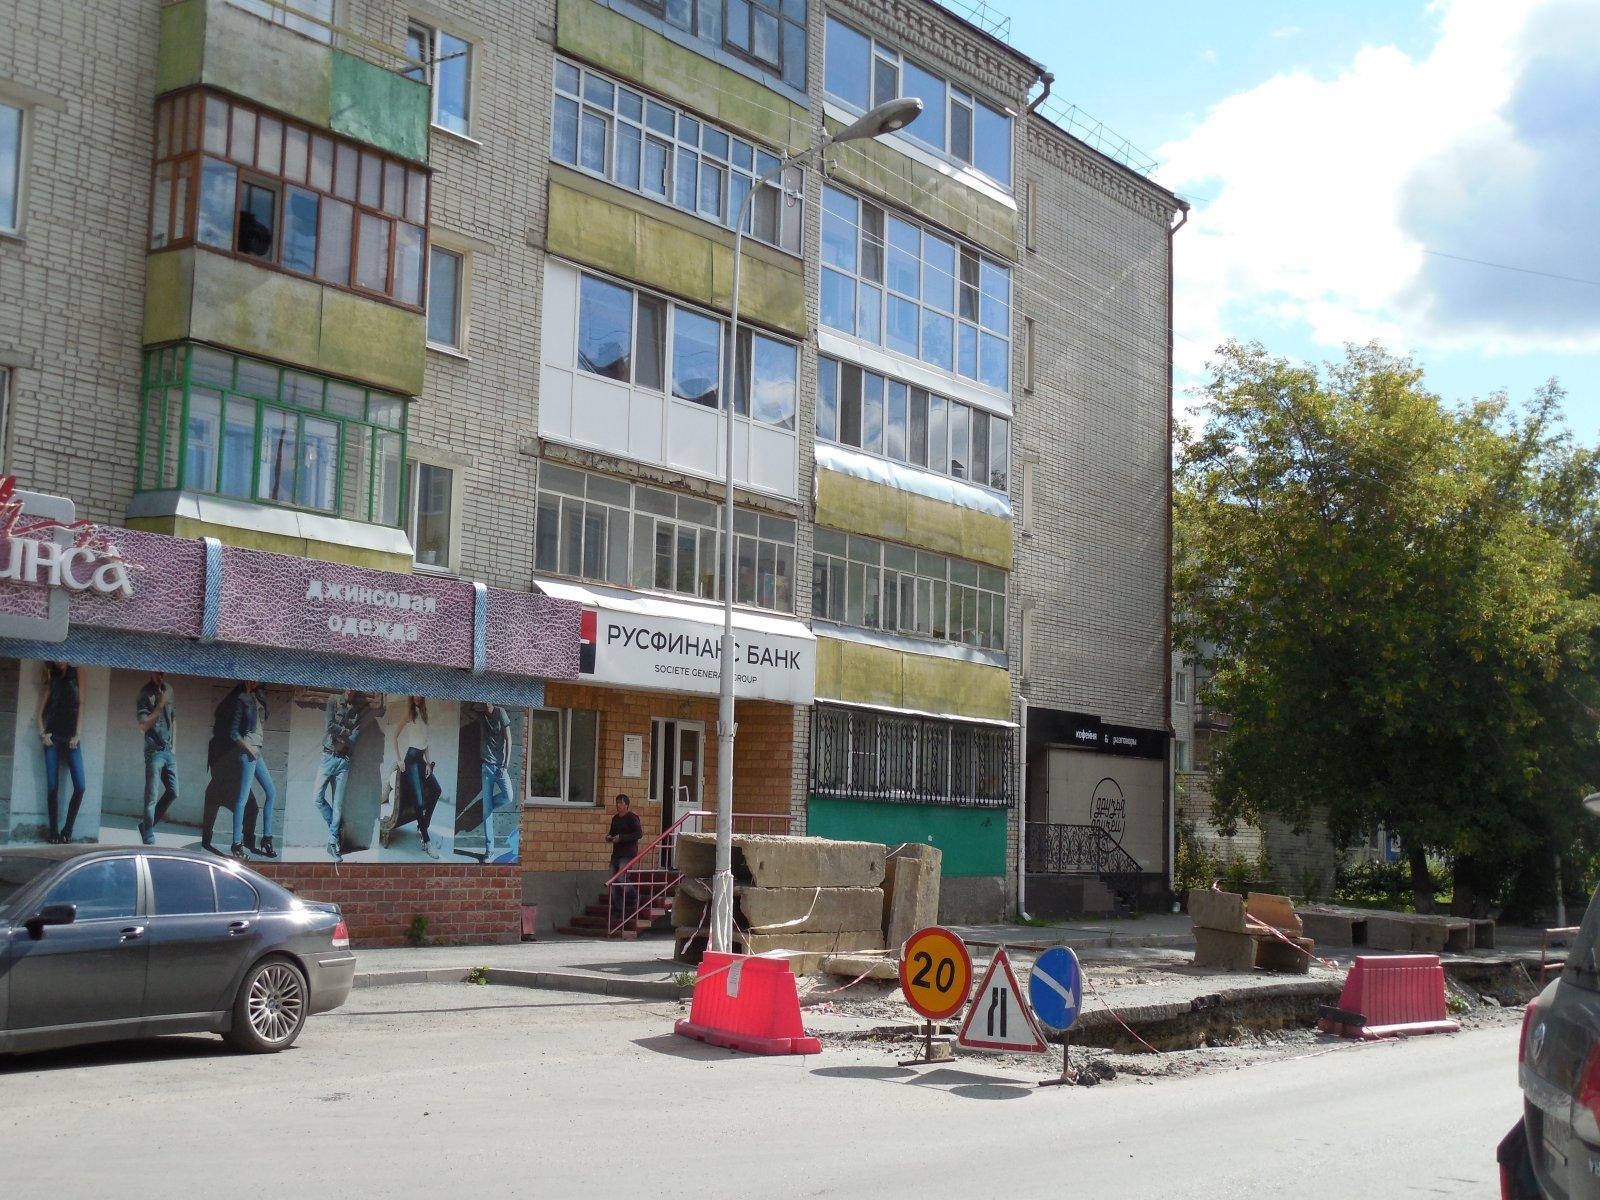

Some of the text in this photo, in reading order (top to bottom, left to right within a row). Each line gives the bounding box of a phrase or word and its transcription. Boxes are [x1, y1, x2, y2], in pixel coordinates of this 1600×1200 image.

[328, 614, 418, 643] одежда
[654, 664, 690, 677] SOCIETE
[747, 644, 801, 670] БАНК
[911, 951, 955, 993] 20
